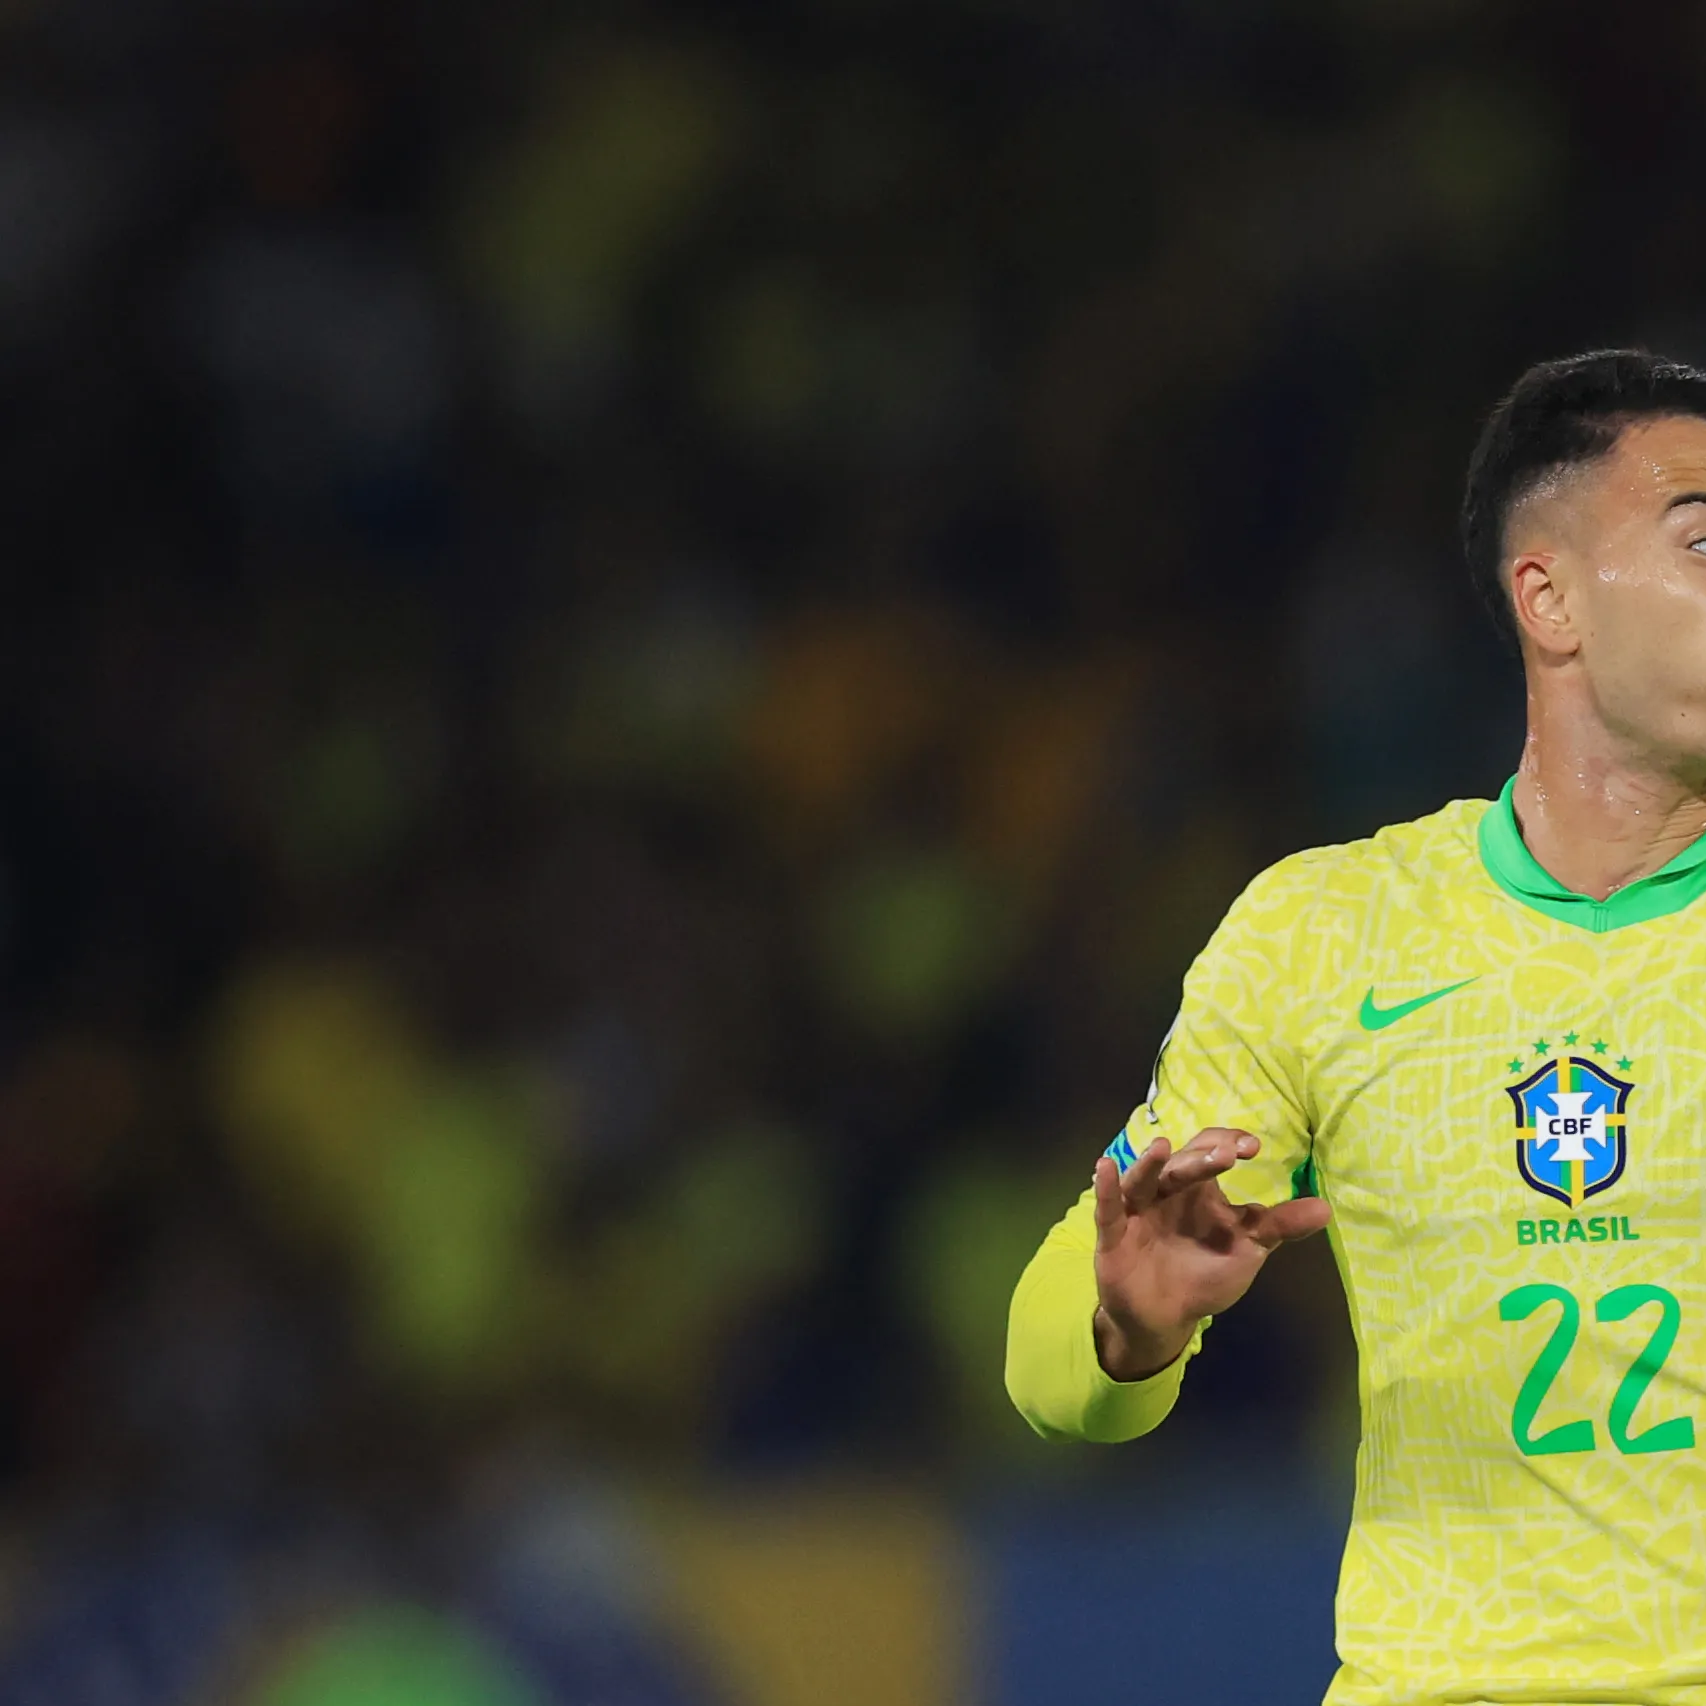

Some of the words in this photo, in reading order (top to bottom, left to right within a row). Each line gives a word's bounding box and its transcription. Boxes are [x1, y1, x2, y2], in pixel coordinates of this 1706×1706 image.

[1547, 1117, 1592, 1136] CBF
[1517, 1216, 1640, 1246] BRASIL
[1498, 1283, 1696, 1457] 22
